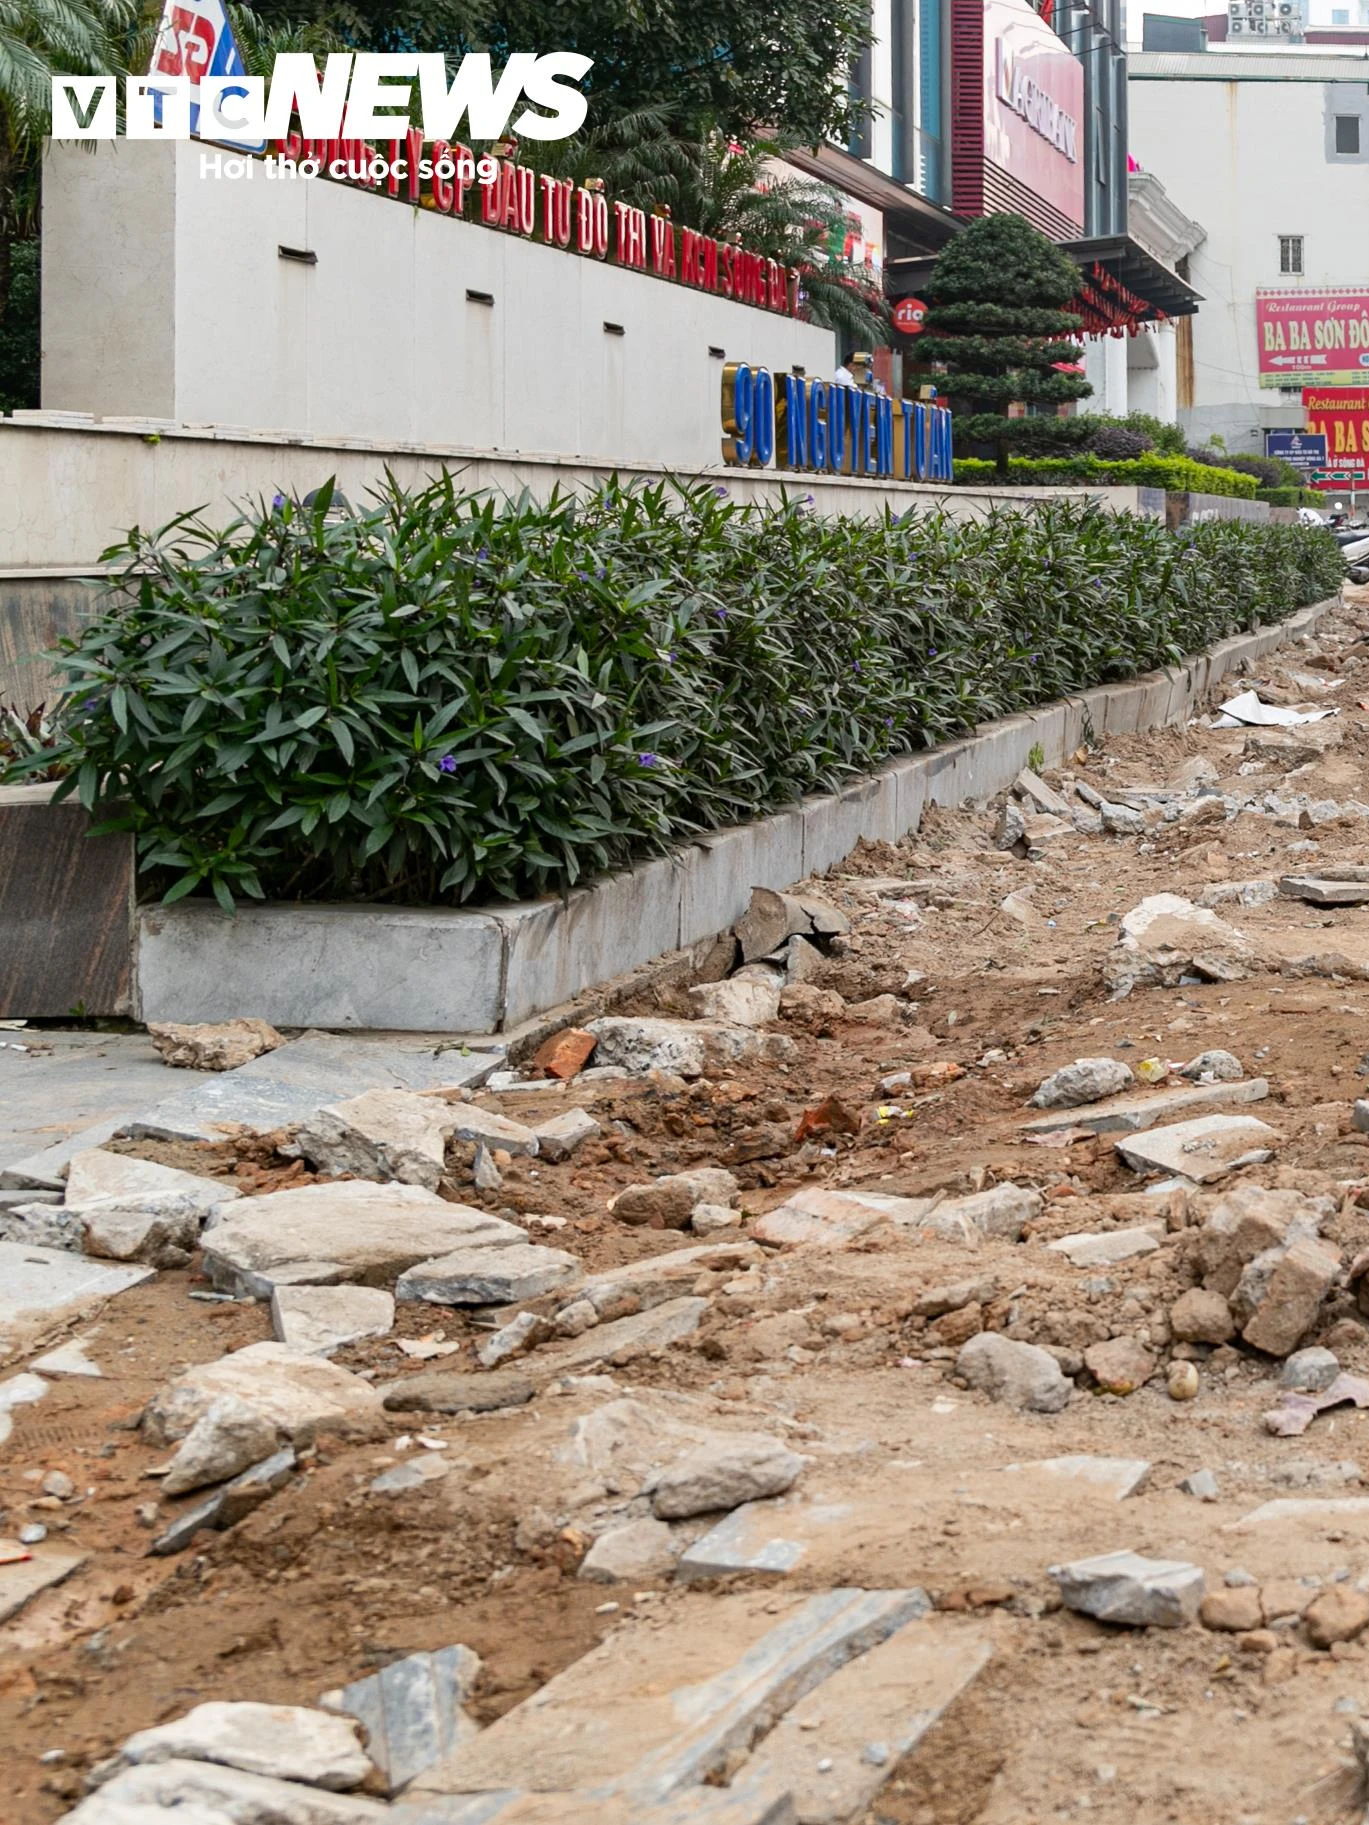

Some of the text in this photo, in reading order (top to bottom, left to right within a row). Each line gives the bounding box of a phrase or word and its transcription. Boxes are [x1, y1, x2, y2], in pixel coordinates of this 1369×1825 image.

[650, 204, 677, 280] VÀ
[681, 225, 717, 292] KCN
[1266, 300, 1361, 313] Restaurant Group
[1264, 321, 1287, 351] BA
[1288, 319, 1312, 351] BA
[1314, 316, 1346, 350] SƠN
[722, 361, 772, 466] 90
[1308, 396, 1365, 411] Restaurant
[1334, 421, 1358, 453] BA
